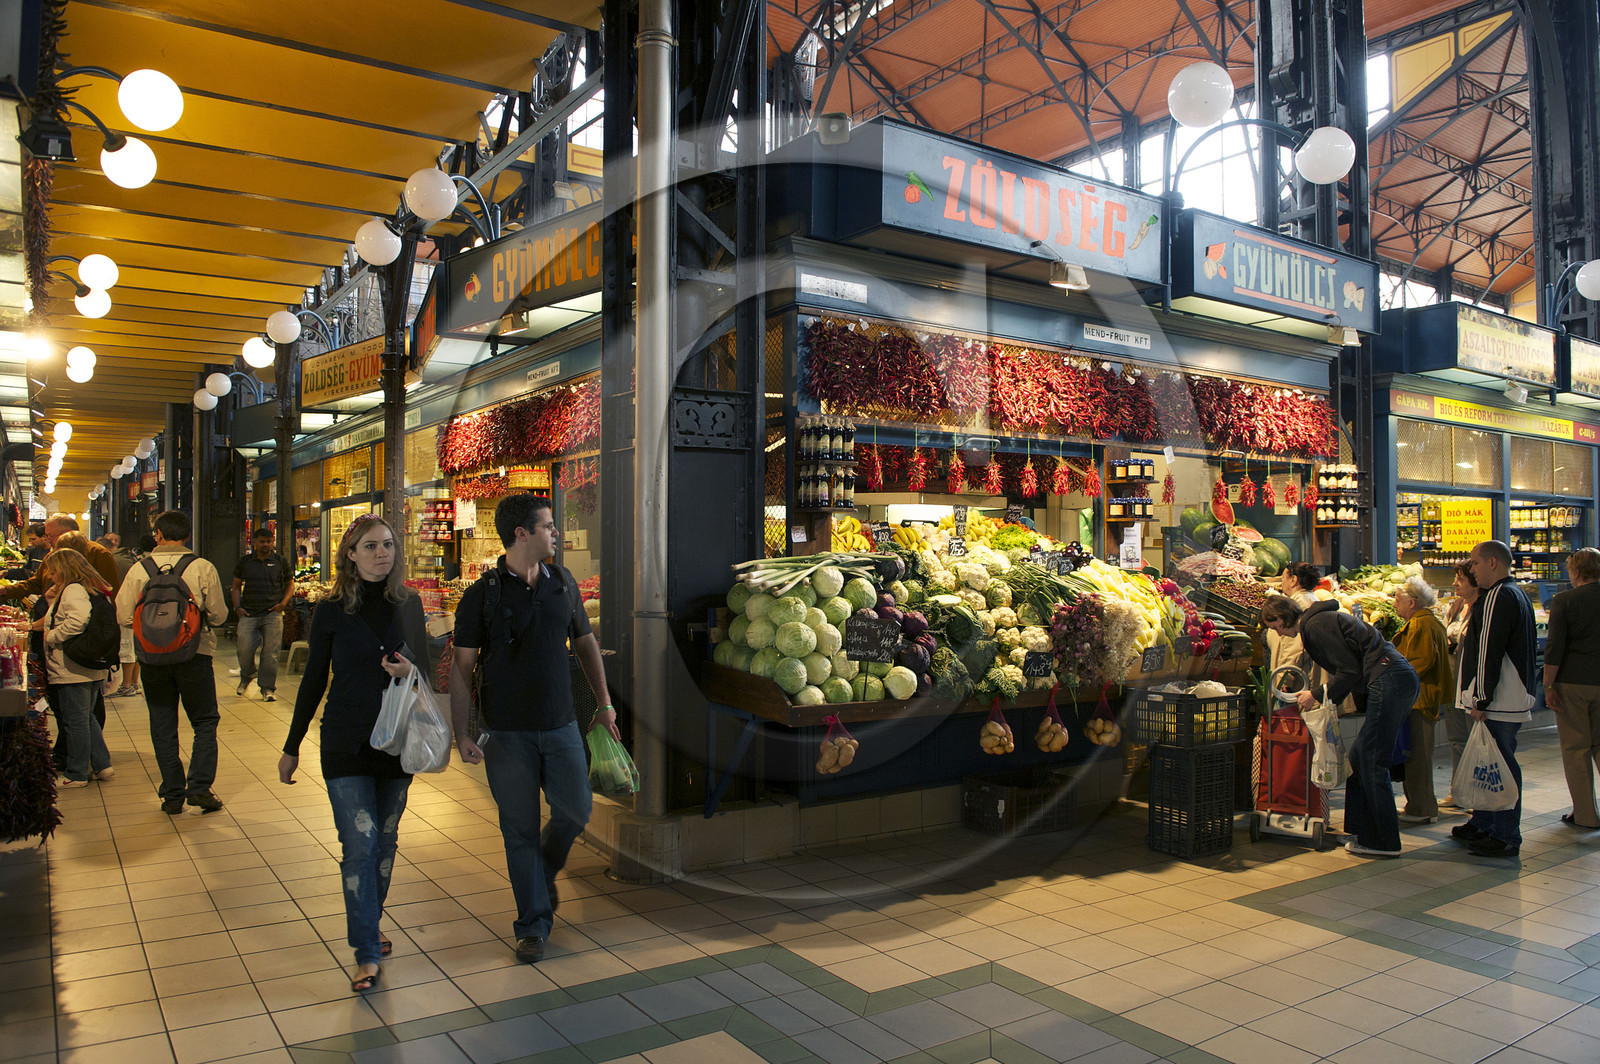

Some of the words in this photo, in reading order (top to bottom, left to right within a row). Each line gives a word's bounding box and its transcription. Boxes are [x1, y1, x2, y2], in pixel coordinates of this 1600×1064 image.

[943, 155, 1127, 259] ZÖLDSÉG
[492, 221, 600, 303] GYÜMÖLC
[1233, 242, 1337, 310] GYÜMÖLCS
[1085, 327, 1130, 342] MEND-FRUIT
[323, 379, 380, 397] KISKERESKED
[1396, 393, 1416, 408] GÁPA
[1440, 402, 1453, 416] BIÓ
[1454, 403, 1463, 417] ÉS
[1464, 407, 1493, 422] REFORM
[1446, 508, 1462, 517] DIÓ
[1465, 508, 1484, 517] MÁK
[1446, 528, 1486, 536] DARÁLVA
